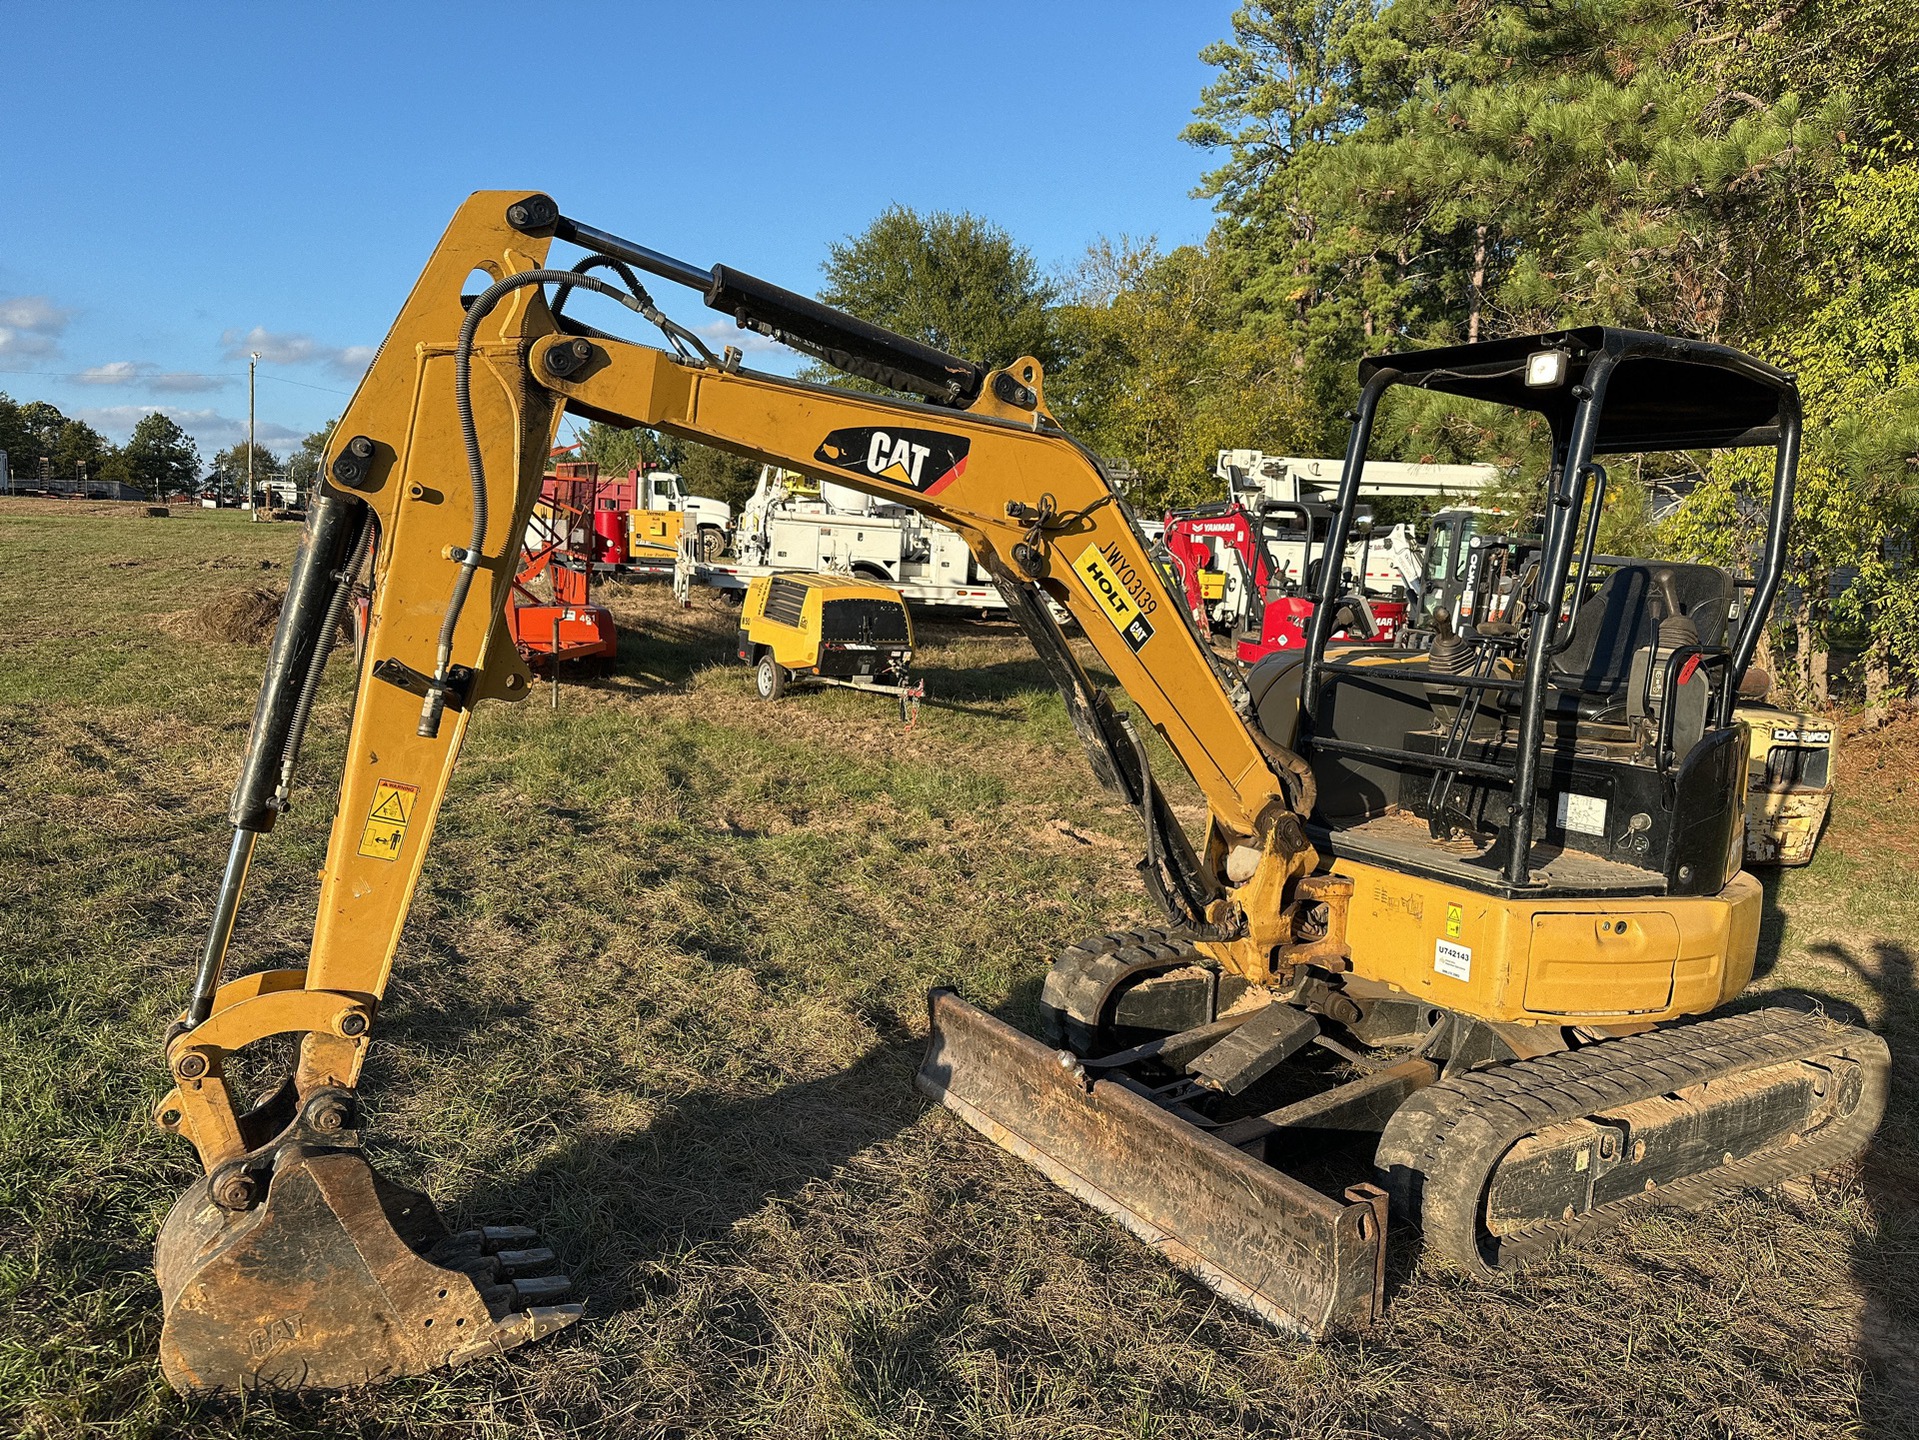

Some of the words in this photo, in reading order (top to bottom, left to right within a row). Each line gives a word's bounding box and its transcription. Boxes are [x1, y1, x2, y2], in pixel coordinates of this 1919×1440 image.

[866, 431, 931, 487] CAT
[1204, 523, 1236, 532] YANMAR
[1086, 562, 1129, 613] HOLT
[1099, 541, 1158, 616] JWY03139
[1129, 620, 1148, 642] CAT
[1774, 729, 1830, 743] DAEWOO
[389, 783, 415, 792] WARNING
[1438, 945, 1470, 962] U742143
[248, 1312, 305, 1360] CAT
